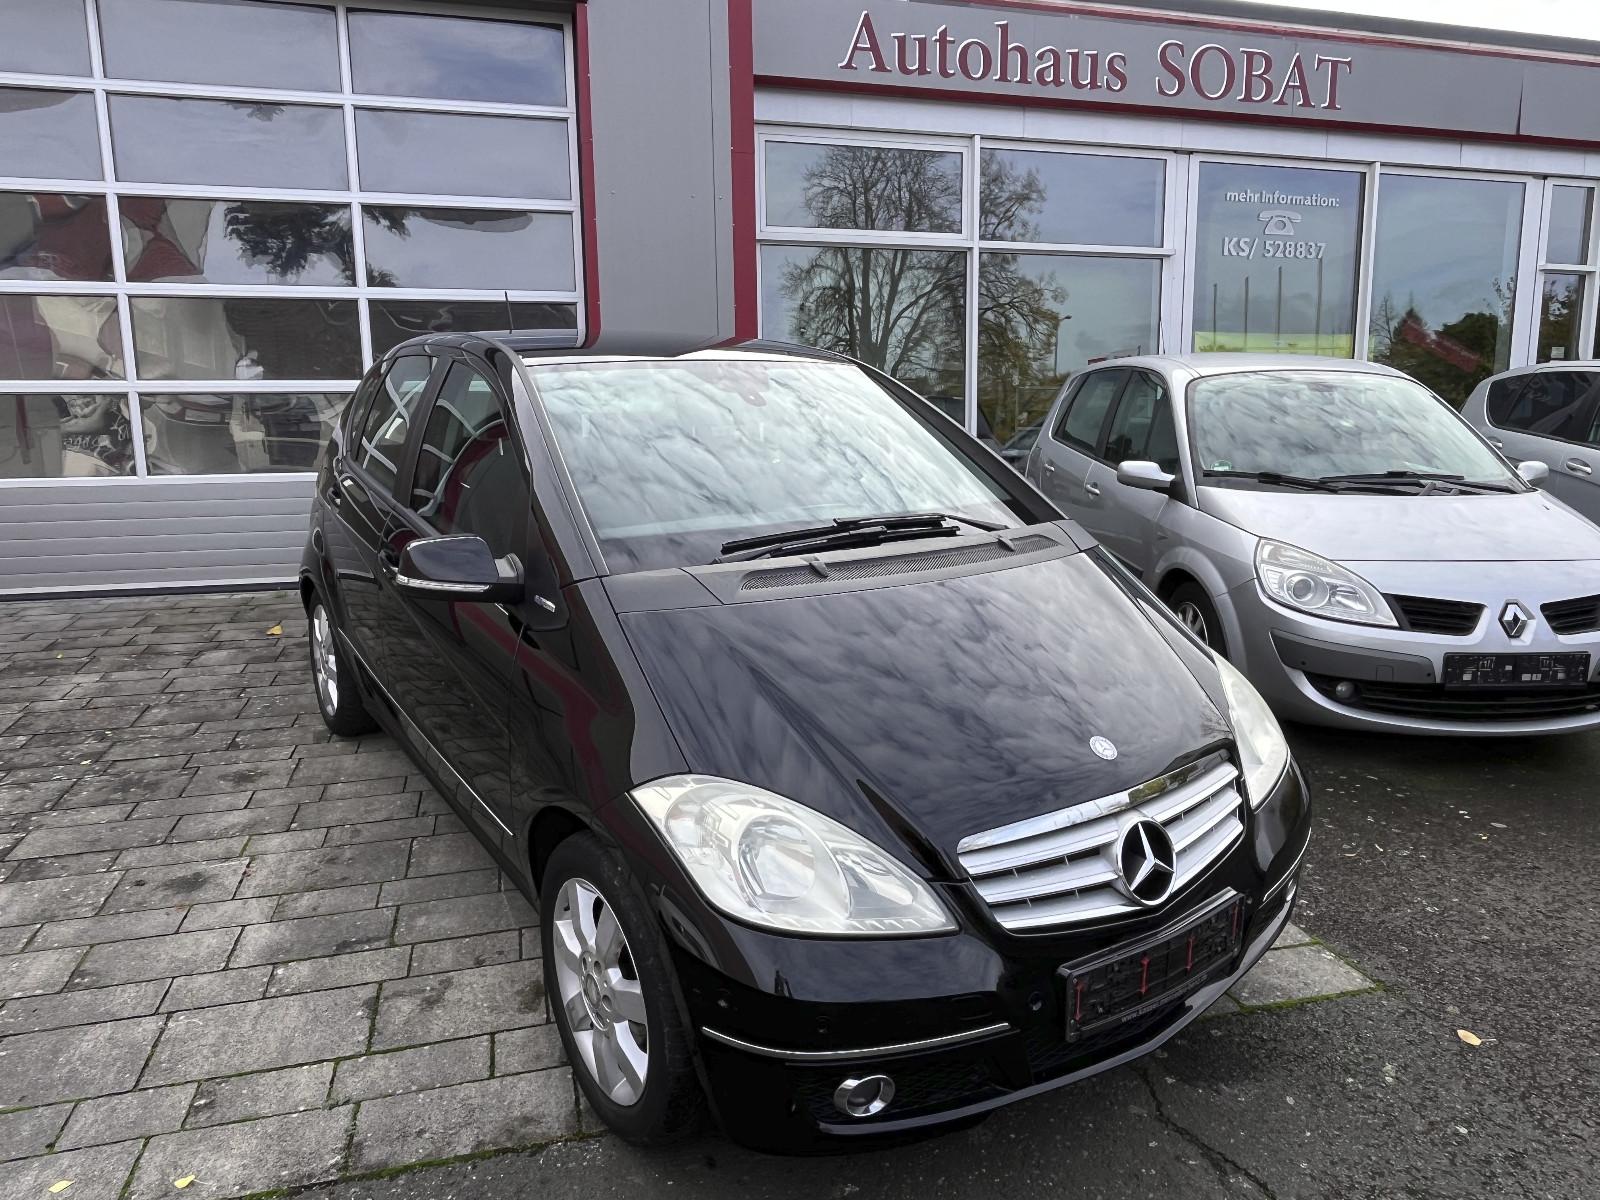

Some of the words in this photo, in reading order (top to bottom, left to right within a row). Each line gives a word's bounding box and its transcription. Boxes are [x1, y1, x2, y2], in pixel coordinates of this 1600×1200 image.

[837, 10, 1128, 93] Autohaus
[1155, 39, 1352, 111] SOBAT
[1226, 189, 1261, 203] mehr
[1261, 190, 1340, 207] Information:
[1223, 236, 1259, 260] KS/
[1264, 240, 1328, 259] 528837
